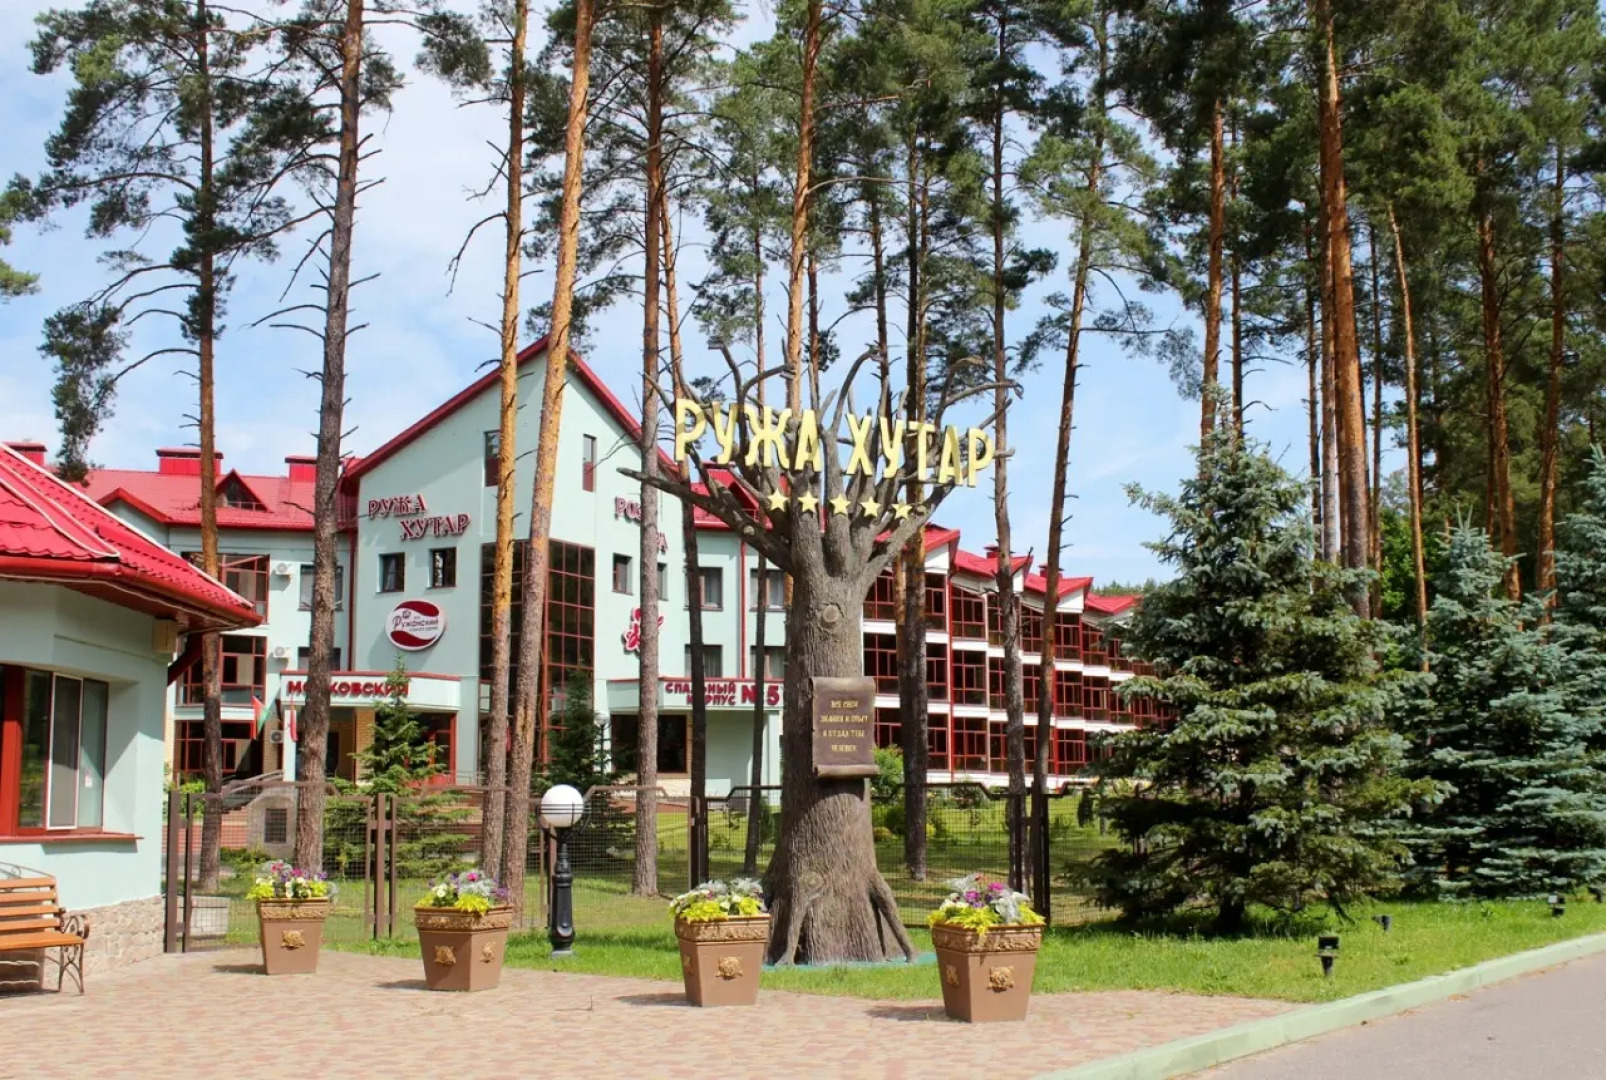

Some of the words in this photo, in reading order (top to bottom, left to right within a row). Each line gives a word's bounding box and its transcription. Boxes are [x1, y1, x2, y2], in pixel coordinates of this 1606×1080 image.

[674, 398, 822, 473] РУЖА
[845, 413, 996, 488] ХУТАР
[368, 494, 427, 519] РУЖА
[400, 513, 471, 541] ХУТАР
[665, 681, 737, 695] СПАНЫЙ
[686, 695, 737, 706] КРПУС
